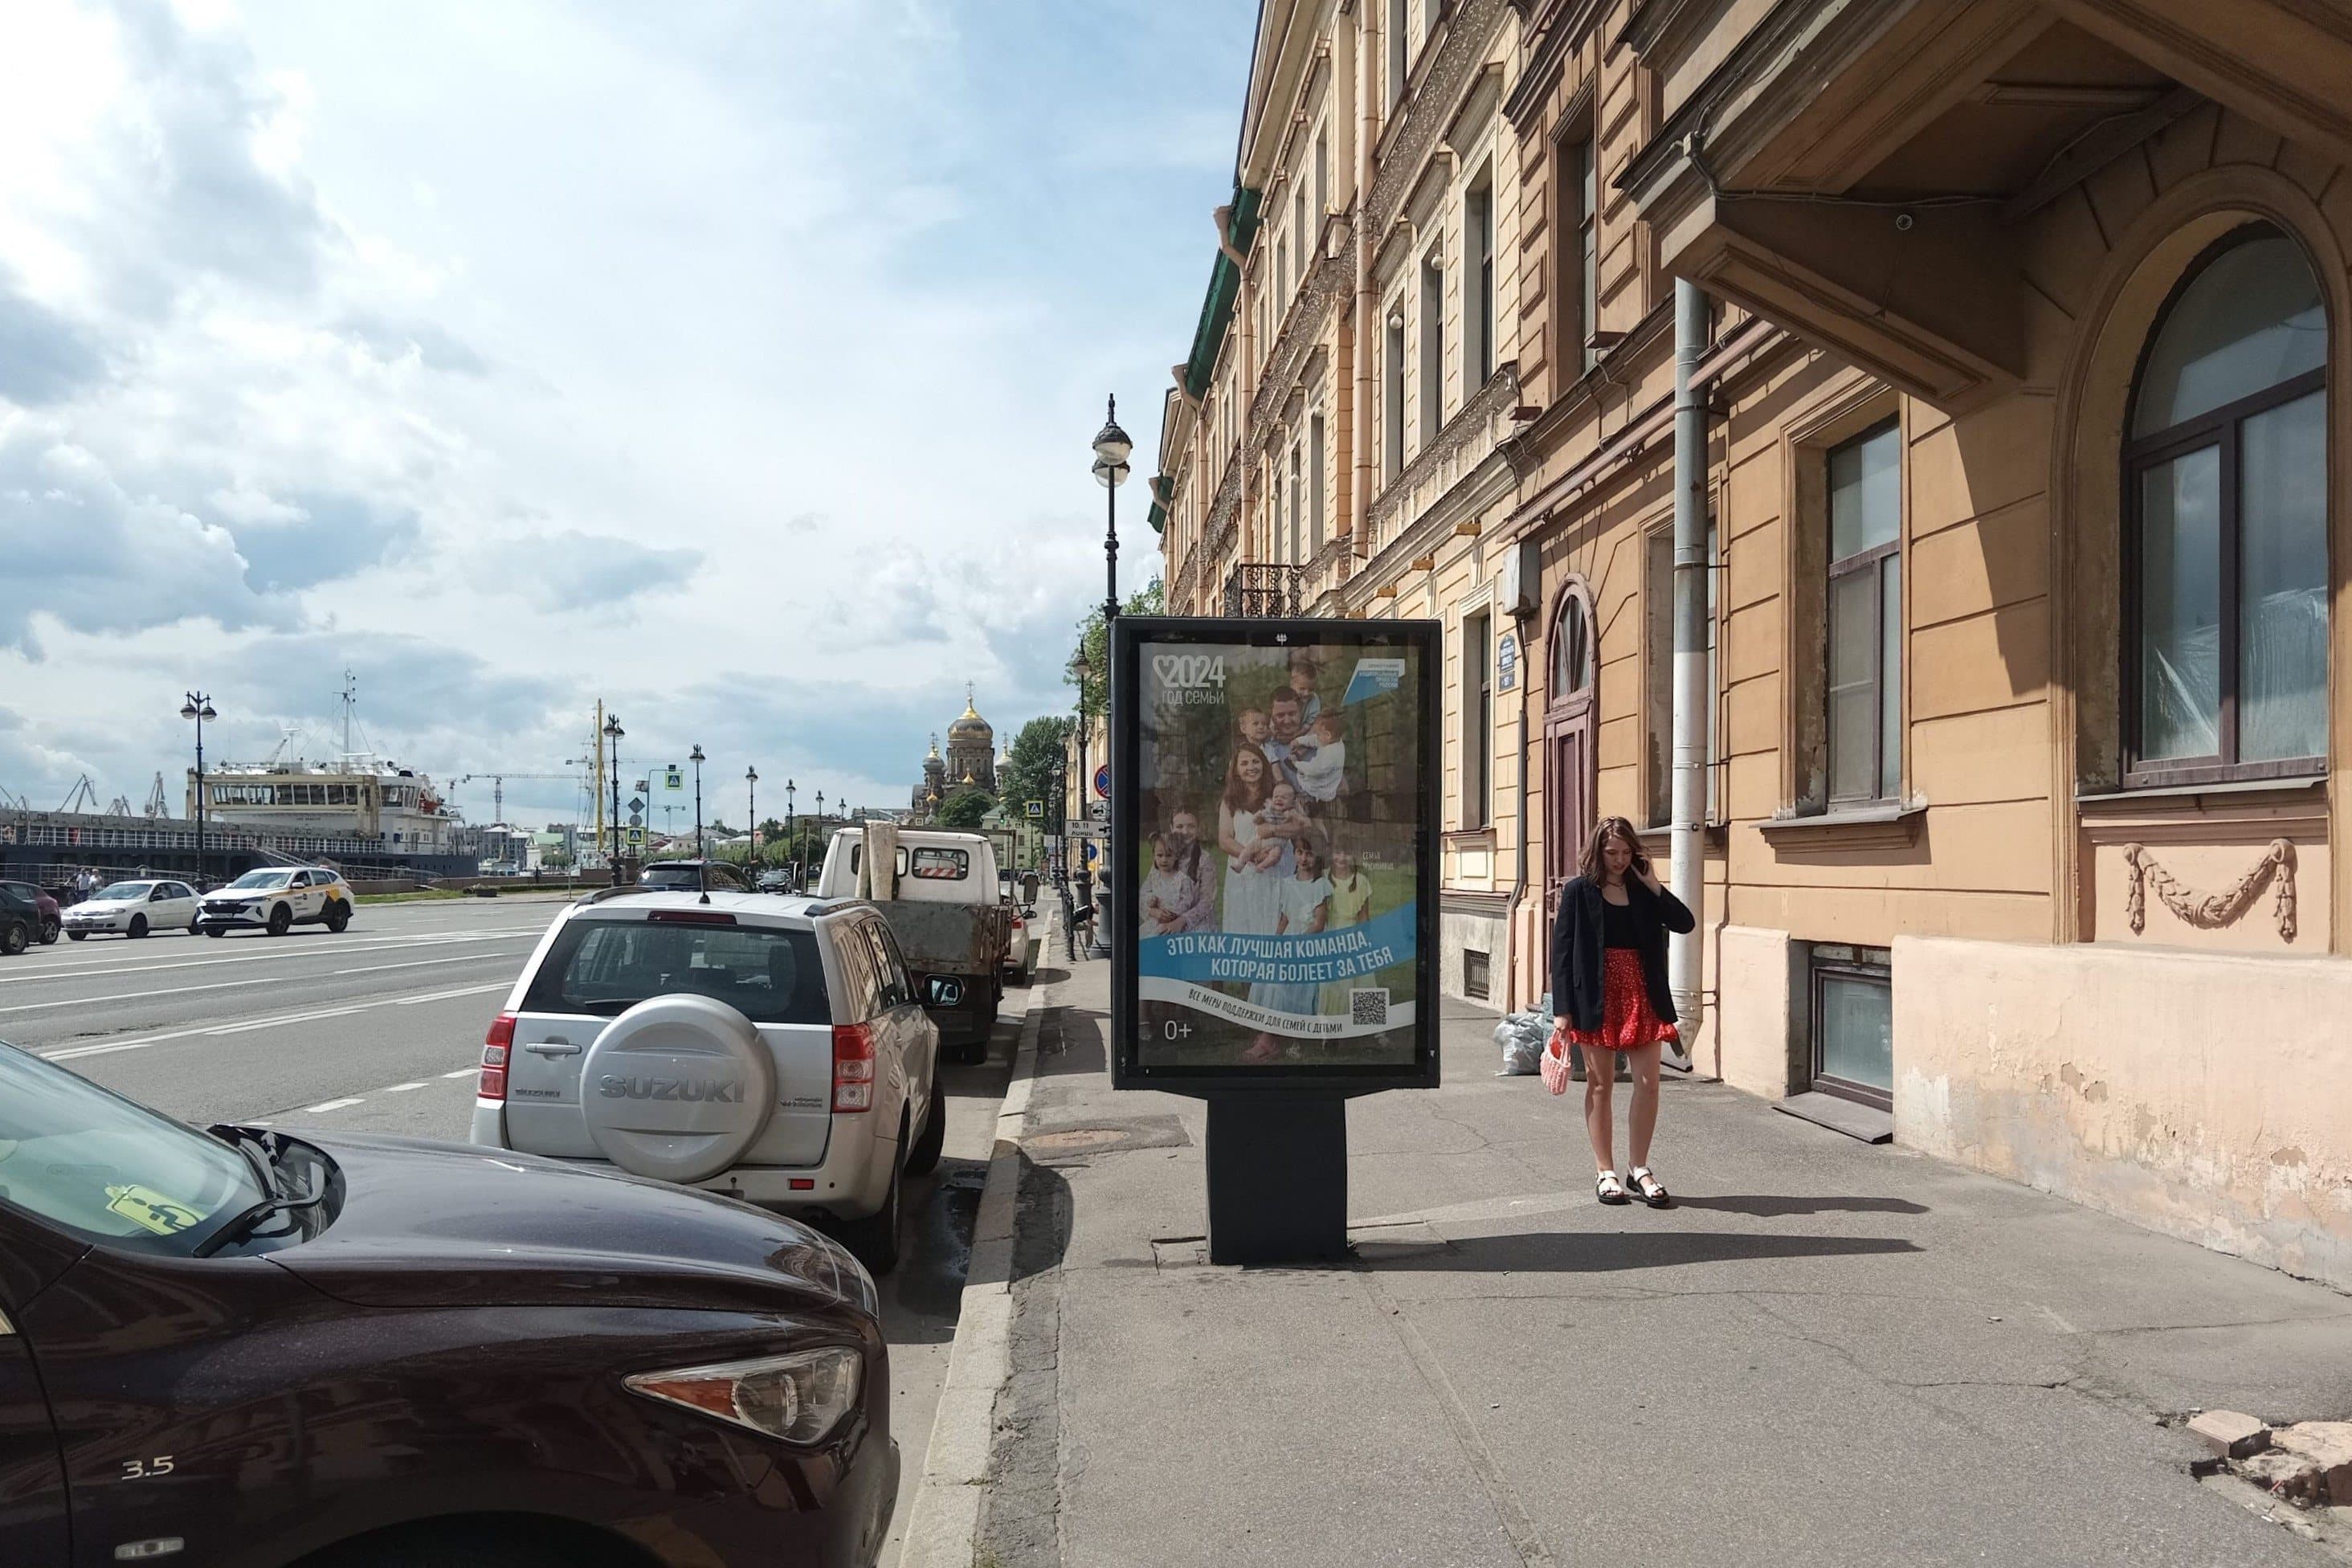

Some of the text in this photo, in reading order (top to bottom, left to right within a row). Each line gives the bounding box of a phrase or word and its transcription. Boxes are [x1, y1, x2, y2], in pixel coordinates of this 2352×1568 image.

[1162, 655, 1227, 688] 2024
[1167, 930, 1372, 958] ЭТО КАК ЛУЧШАЯ КОМАНДА,
[1211, 945, 1394, 982] КОТОРАЯ БОЛЕЕТ ЗА ТЕБЯ
[1188, 988, 1343, 1035] ВСЕ МЕРЫ ПОДДЕРЖКИ ДЛЯ СЕМЕЙ С ДЕТЬМИ
[1165, 1020, 1192, 1040] 0+
[599, 1073, 745, 1103] SUZUKI
[121, 1455, 174, 1480] 3.5
